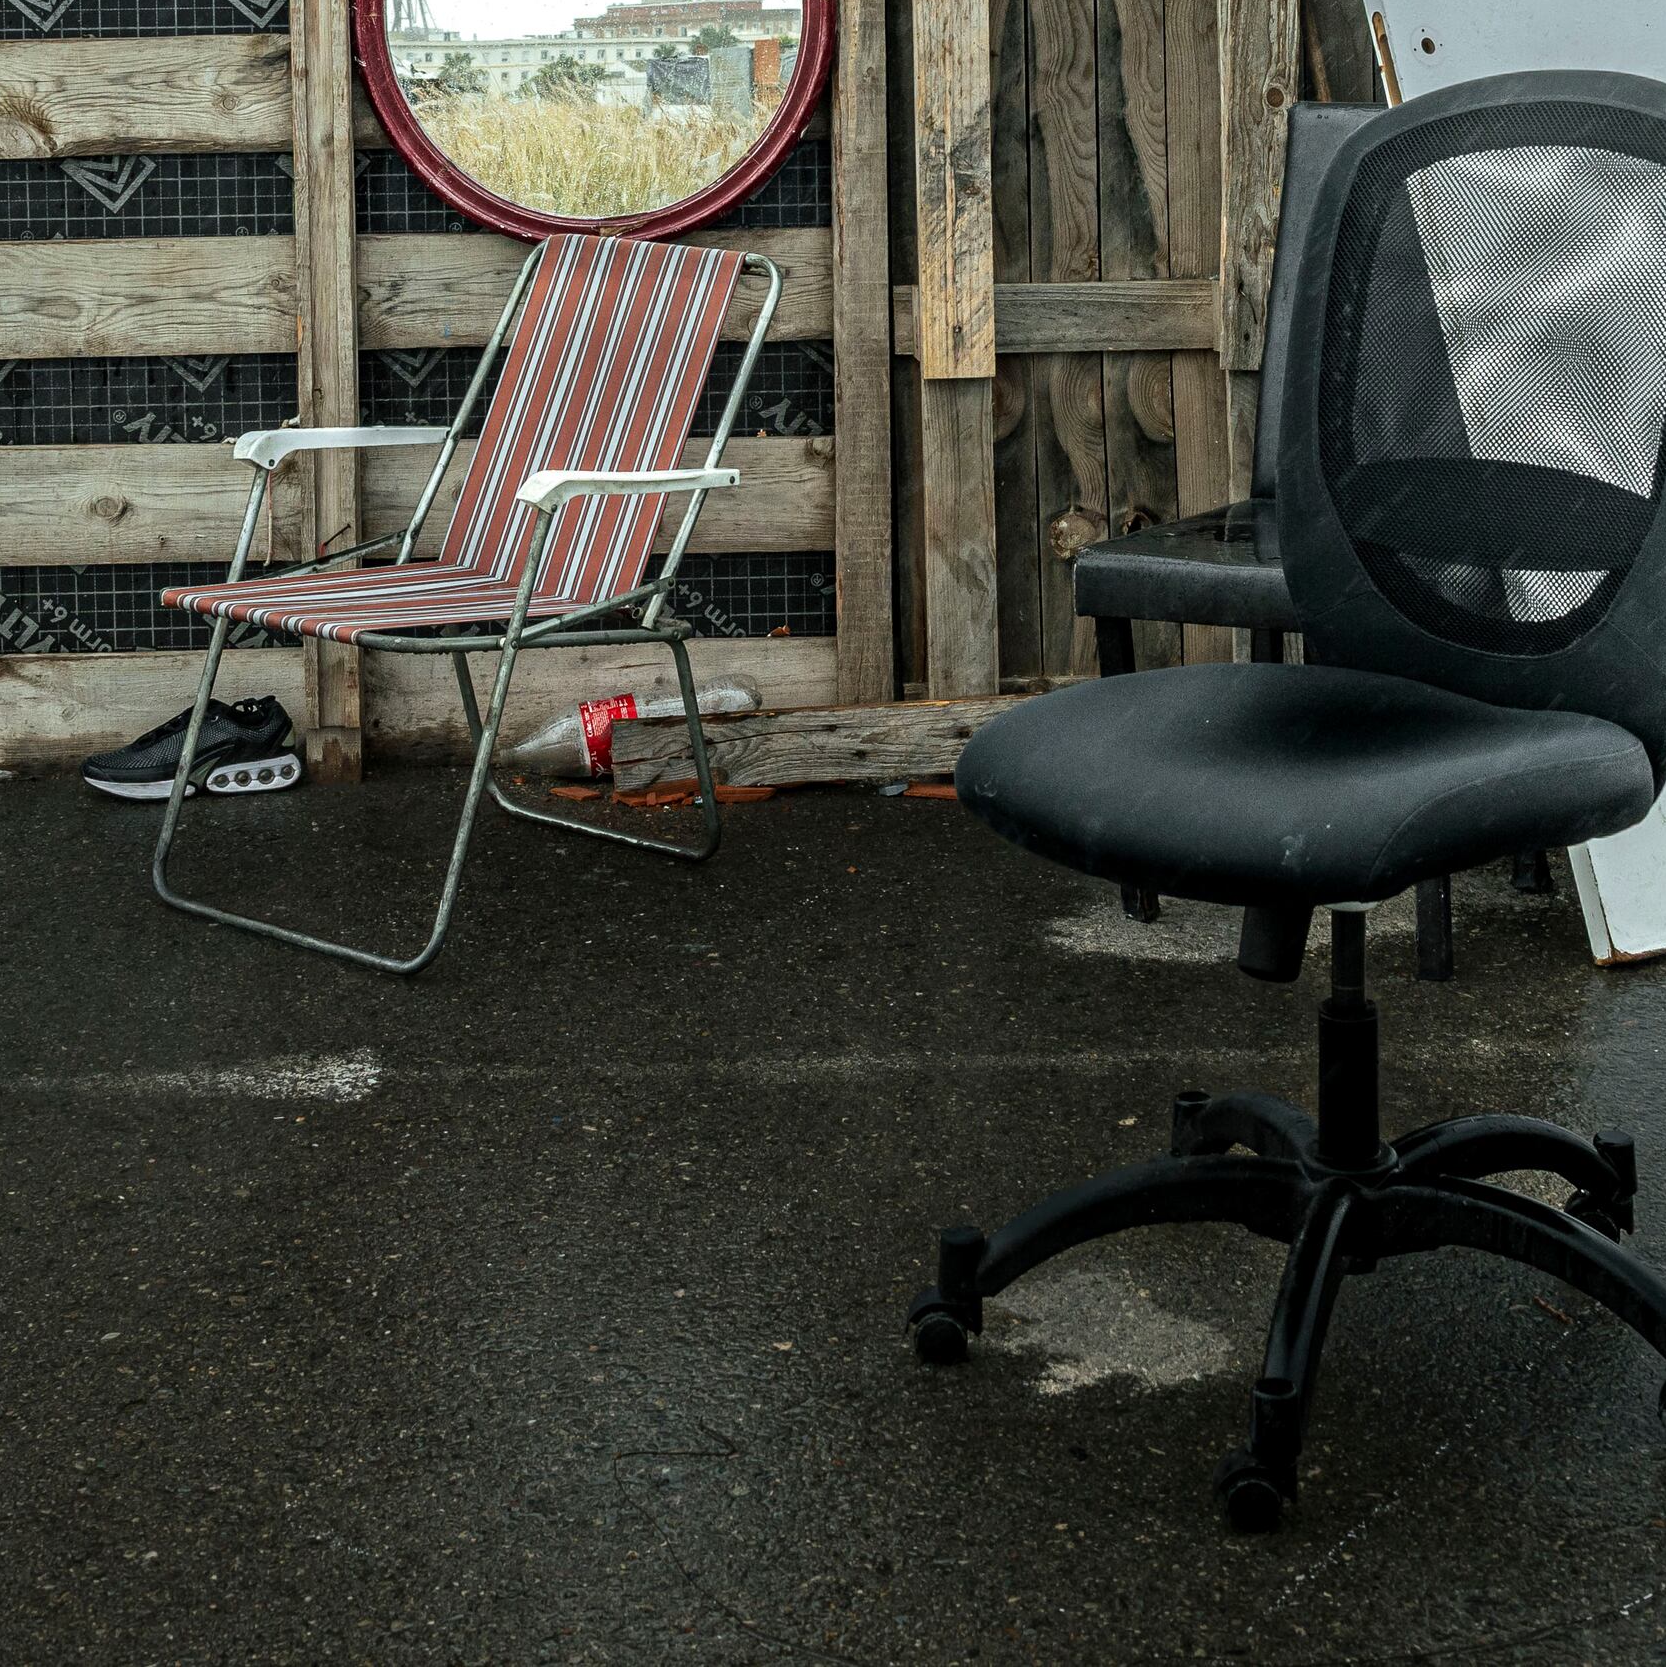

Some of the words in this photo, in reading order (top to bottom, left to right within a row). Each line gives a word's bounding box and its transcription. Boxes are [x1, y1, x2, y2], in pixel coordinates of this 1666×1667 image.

[42, 598, 68, 623] 6+
[678, 584, 703, 609] 6+
[69, 618, 113, 653] orm
[704, 603, 747, 638] orm
